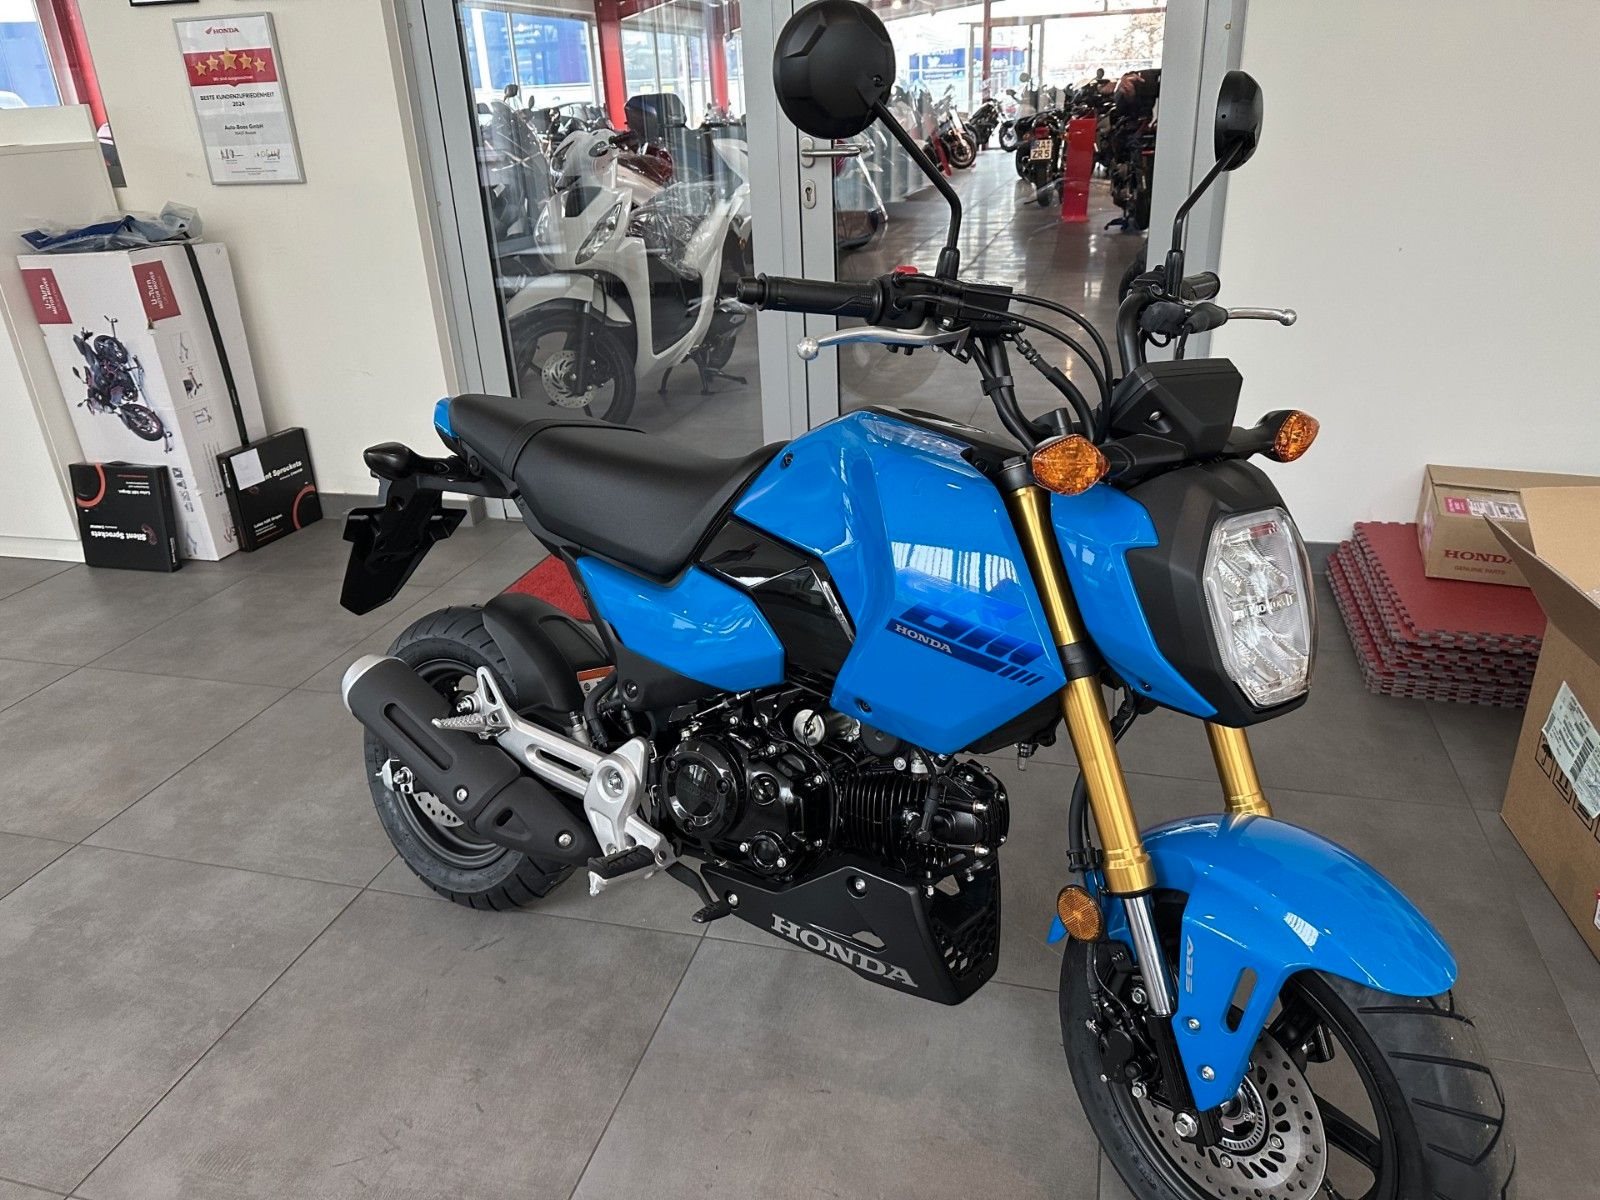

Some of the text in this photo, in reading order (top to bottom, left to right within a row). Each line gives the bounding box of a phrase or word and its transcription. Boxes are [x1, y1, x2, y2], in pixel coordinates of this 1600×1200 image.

[272, 460, 302, 477] Sprockets
[90, 530, 147, 541] Silent Sprockets
[1444, 549, 1512, 565] HOND
[894, 623, 953, 655] HONDA
[771, 913, 919, 988] HONDA
[1185, 934, 1194, 995] ABS
